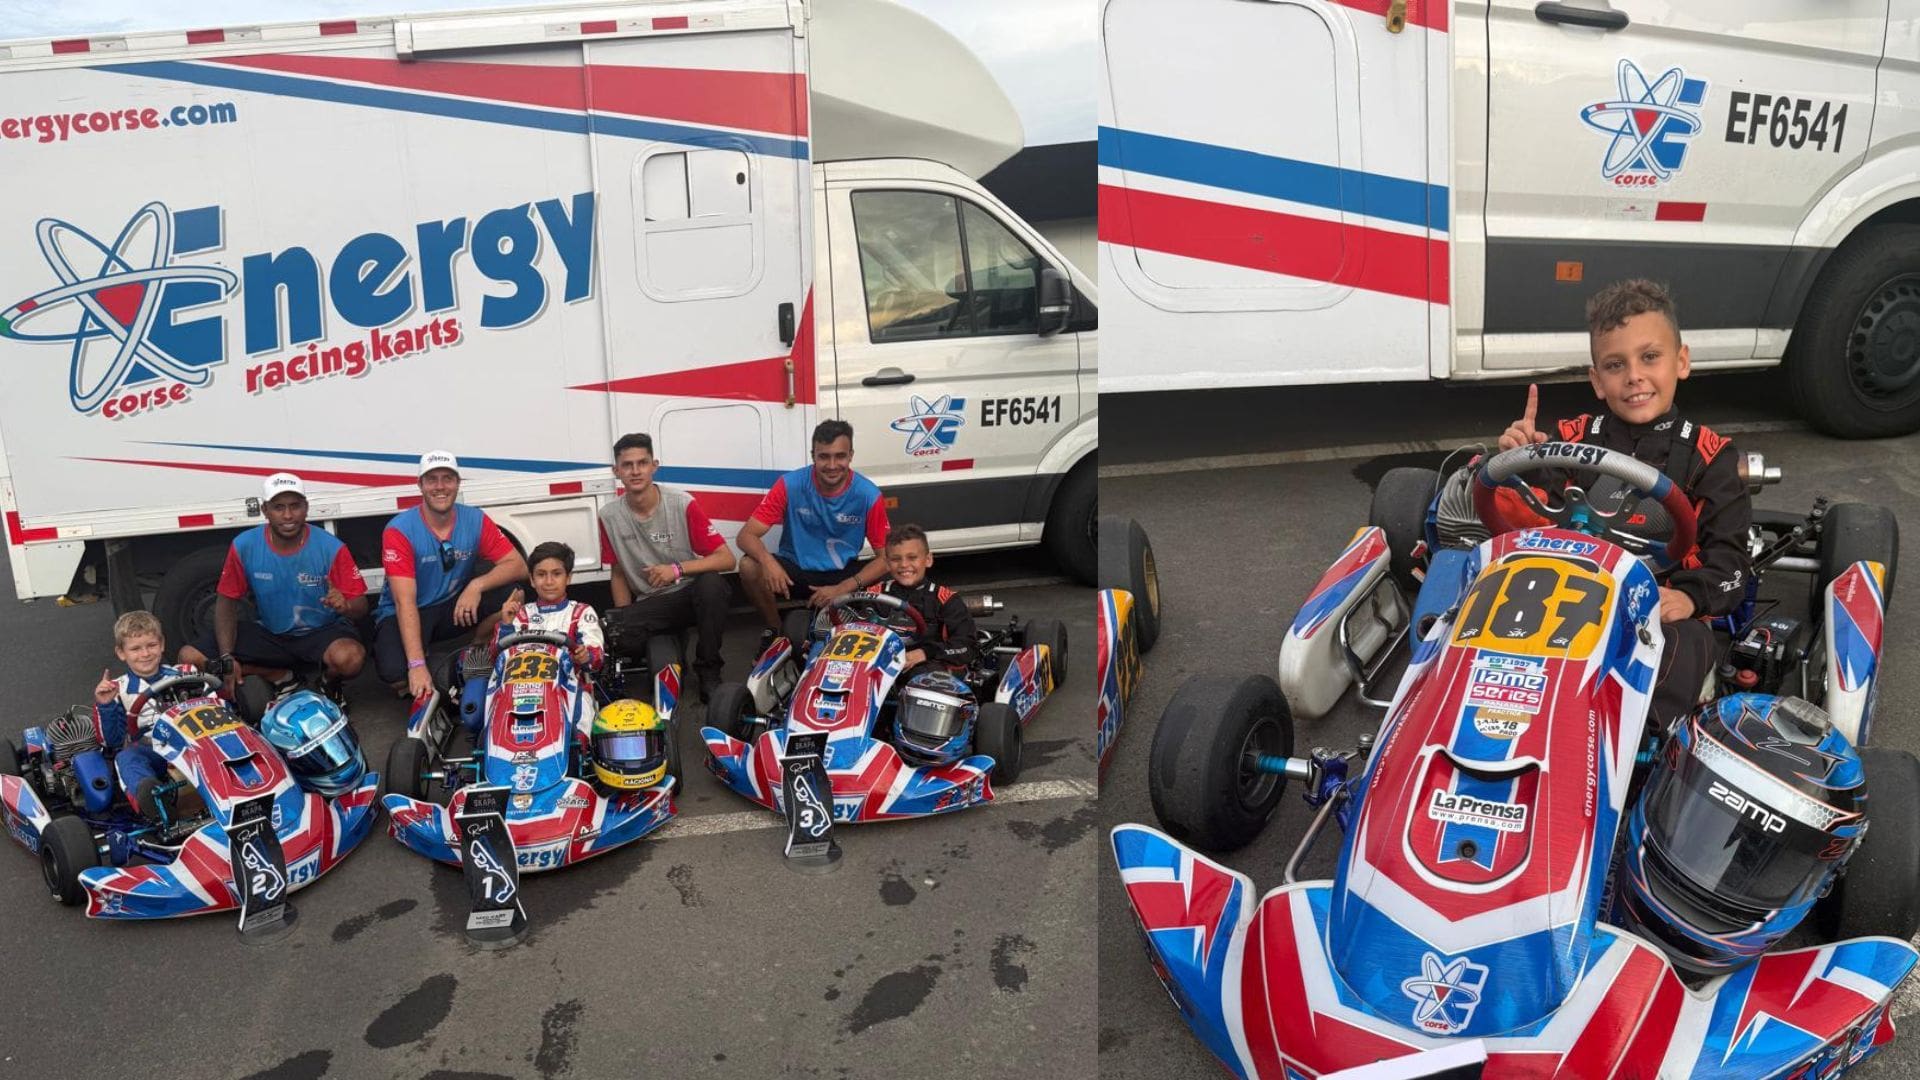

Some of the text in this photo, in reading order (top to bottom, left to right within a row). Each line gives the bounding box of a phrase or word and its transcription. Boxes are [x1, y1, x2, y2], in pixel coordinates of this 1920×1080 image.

[0, 102, 237, 143] ergycorse.com
[1725, 91, 1849, 153] EF6541
[1614, 173, 1657, 186] corse
[60, 190, 597, 385] Energy
[245, 317, 460, 393] racing karts
[103, 383, 187, 418] corse
[981, 395, 1061, 427] EF6541
[913, 448, 941, 457] corse
[1532, 442, 1608, 466] Energy
[1517, 531, 1599, 556] Energy
[1456, 567, 1610, 649] 187
[823, 633, 880, 657] 187
[504, 655, 560, 681] 233
[1472, 685, 1541, 704] series
[178, 706, 242, 737] 188
[1502, 721, 1519, 731] 18
[1584, 709, 1596, 817] energycorse.com
[800, 809, 814, 828] 3
[1434, 793, 1525, 820] La Prensa
[1708, 781, 1787, 833] zamp
[1431, 810, 1522, 829] www.prensa.com
[252, 873, 266, 895] 2
[482, 876, 493, 899] 1
[1424, 1020, 1449, 1031] corse
